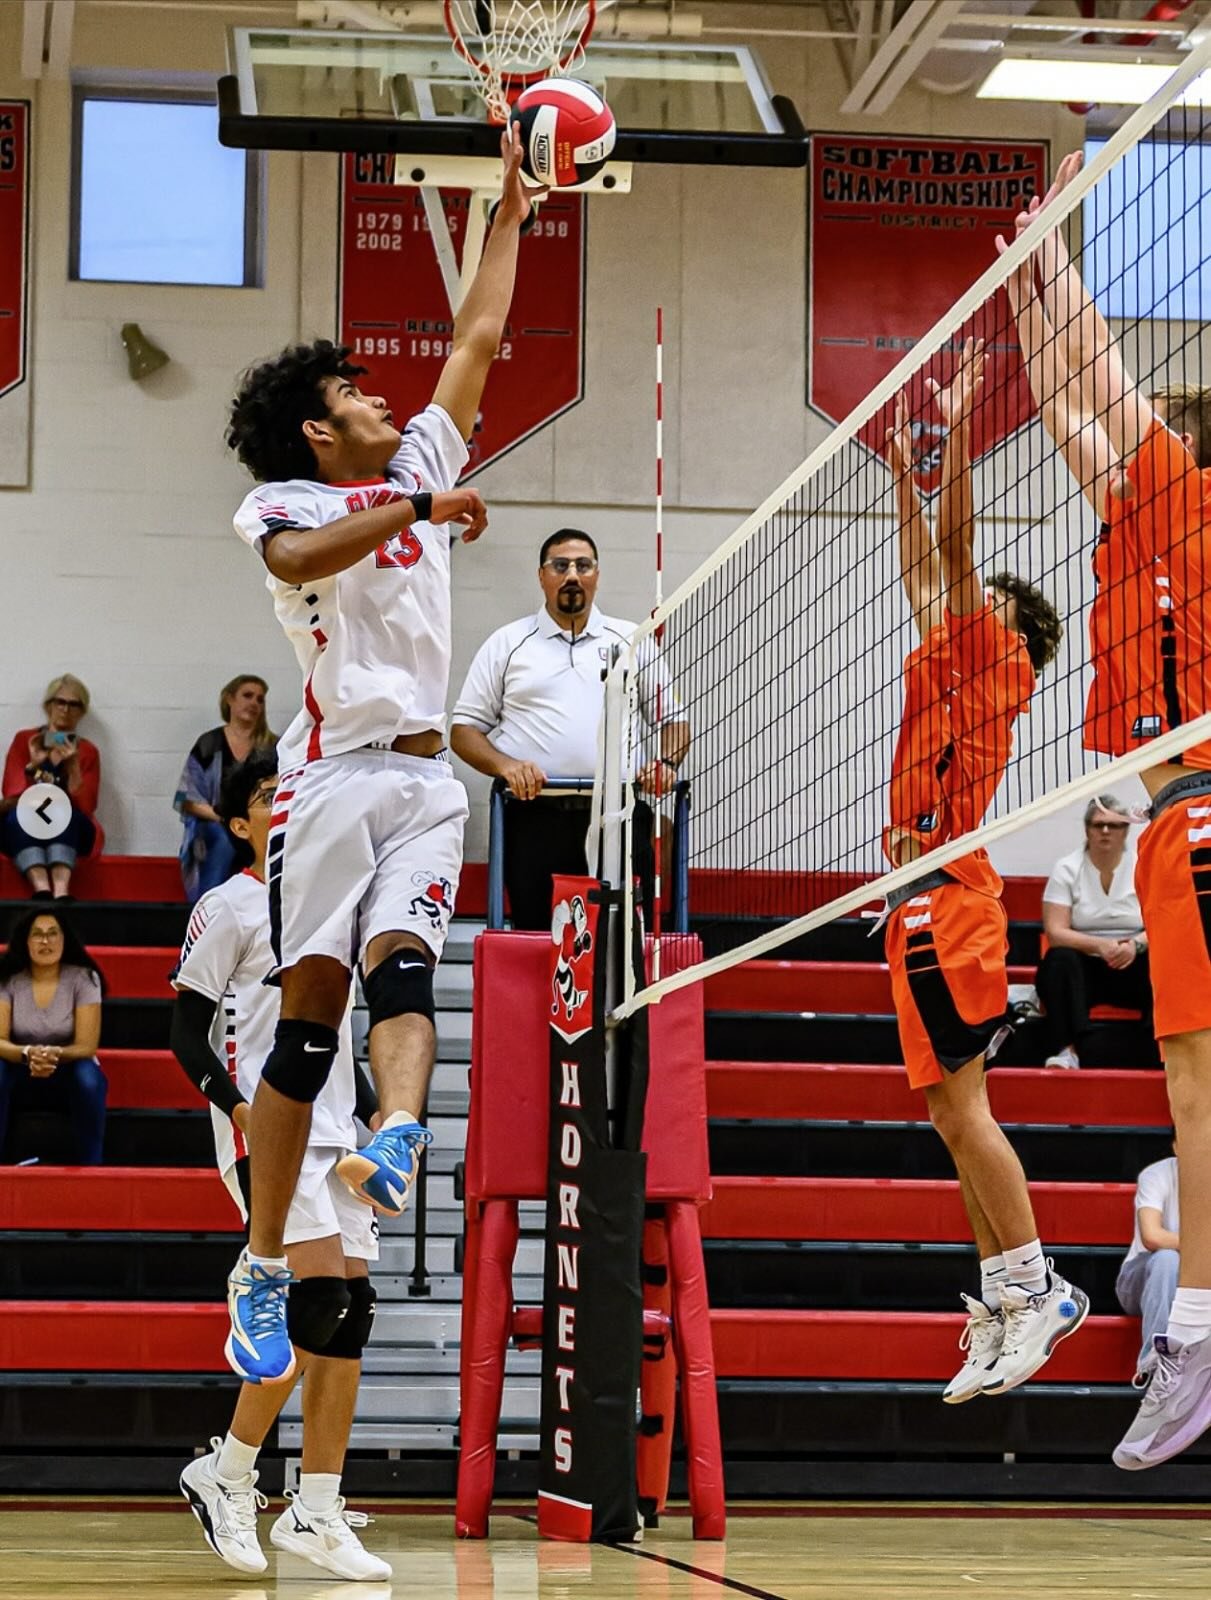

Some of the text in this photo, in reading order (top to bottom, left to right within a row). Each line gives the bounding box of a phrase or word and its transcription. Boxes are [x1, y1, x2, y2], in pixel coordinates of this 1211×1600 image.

[823, 147, 1035, 175] SOFTBALL
[822, 168, 1036, 209] CHAMPIONSHIPS
[357, 213, 402, 230] 1979
[880, 214, 978, 229] DISTRICT
[356, 233, 402, 250] 2002
[354, 337, 400, 355] 1995
[553, 1061, 582, 1474] HORNETS
